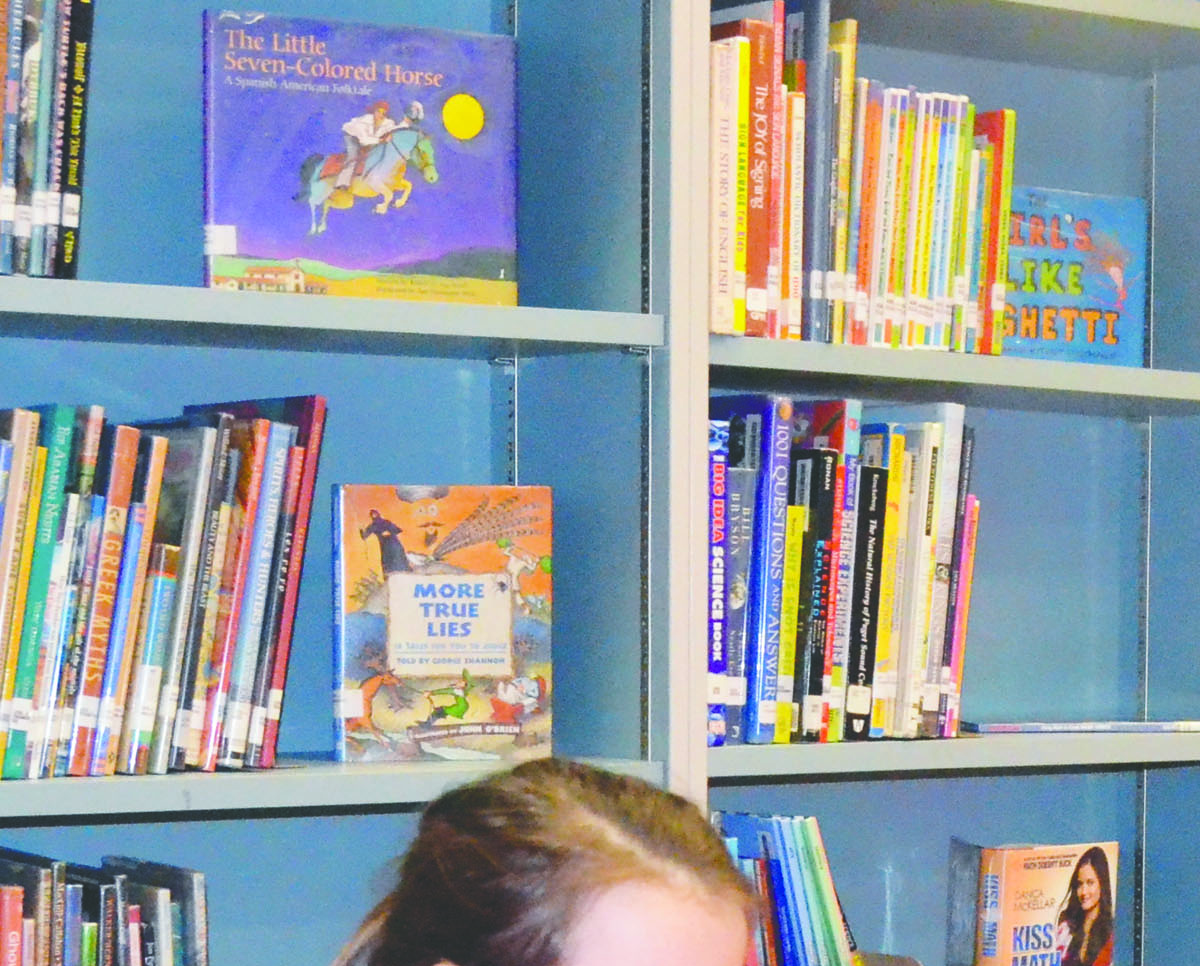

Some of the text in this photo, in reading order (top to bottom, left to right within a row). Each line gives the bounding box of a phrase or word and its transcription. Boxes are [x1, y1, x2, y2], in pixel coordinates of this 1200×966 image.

[225, 29, 327, 56] The Little
[224, 52, 444, 87] Seven-Colored Horse
[280, 79, 330, 93] American
[750, 84, 769, 209] The JOY of Signing
[53, 149, 62, 192] CRACK
[718, 151, 729, 203] STORY
[1009, 211, 1096, 253] IRL'S
[717, 226, 729, 295] ENGLISH
[1003, 303, 1120, 346] GHETTI
[730, 493, 741, 556] BRYSON
[868, 519, 878, 535] The
[711, 463, 725, 663] BIG IDEA SCIENCE BOOK
[764, 424, 790, 700] 1001 QUESTIONS AND ANSWER
[866, 536, 876, 571] Natural
[414, 583, 485, 599] MORE
[813, 540, 825, 617] EXPLAINED
[862, 572, 874, 606] History
[86, 539, 121, 682] GREEK MYTHS
[419, 603, 480, 618] TRUE
[427, 622, 472, 637] LIES
[859, 618, 870, 643] Puget
[858, 644, 868, 672] Sound
[1012, 923, 1054, 953] KISS
